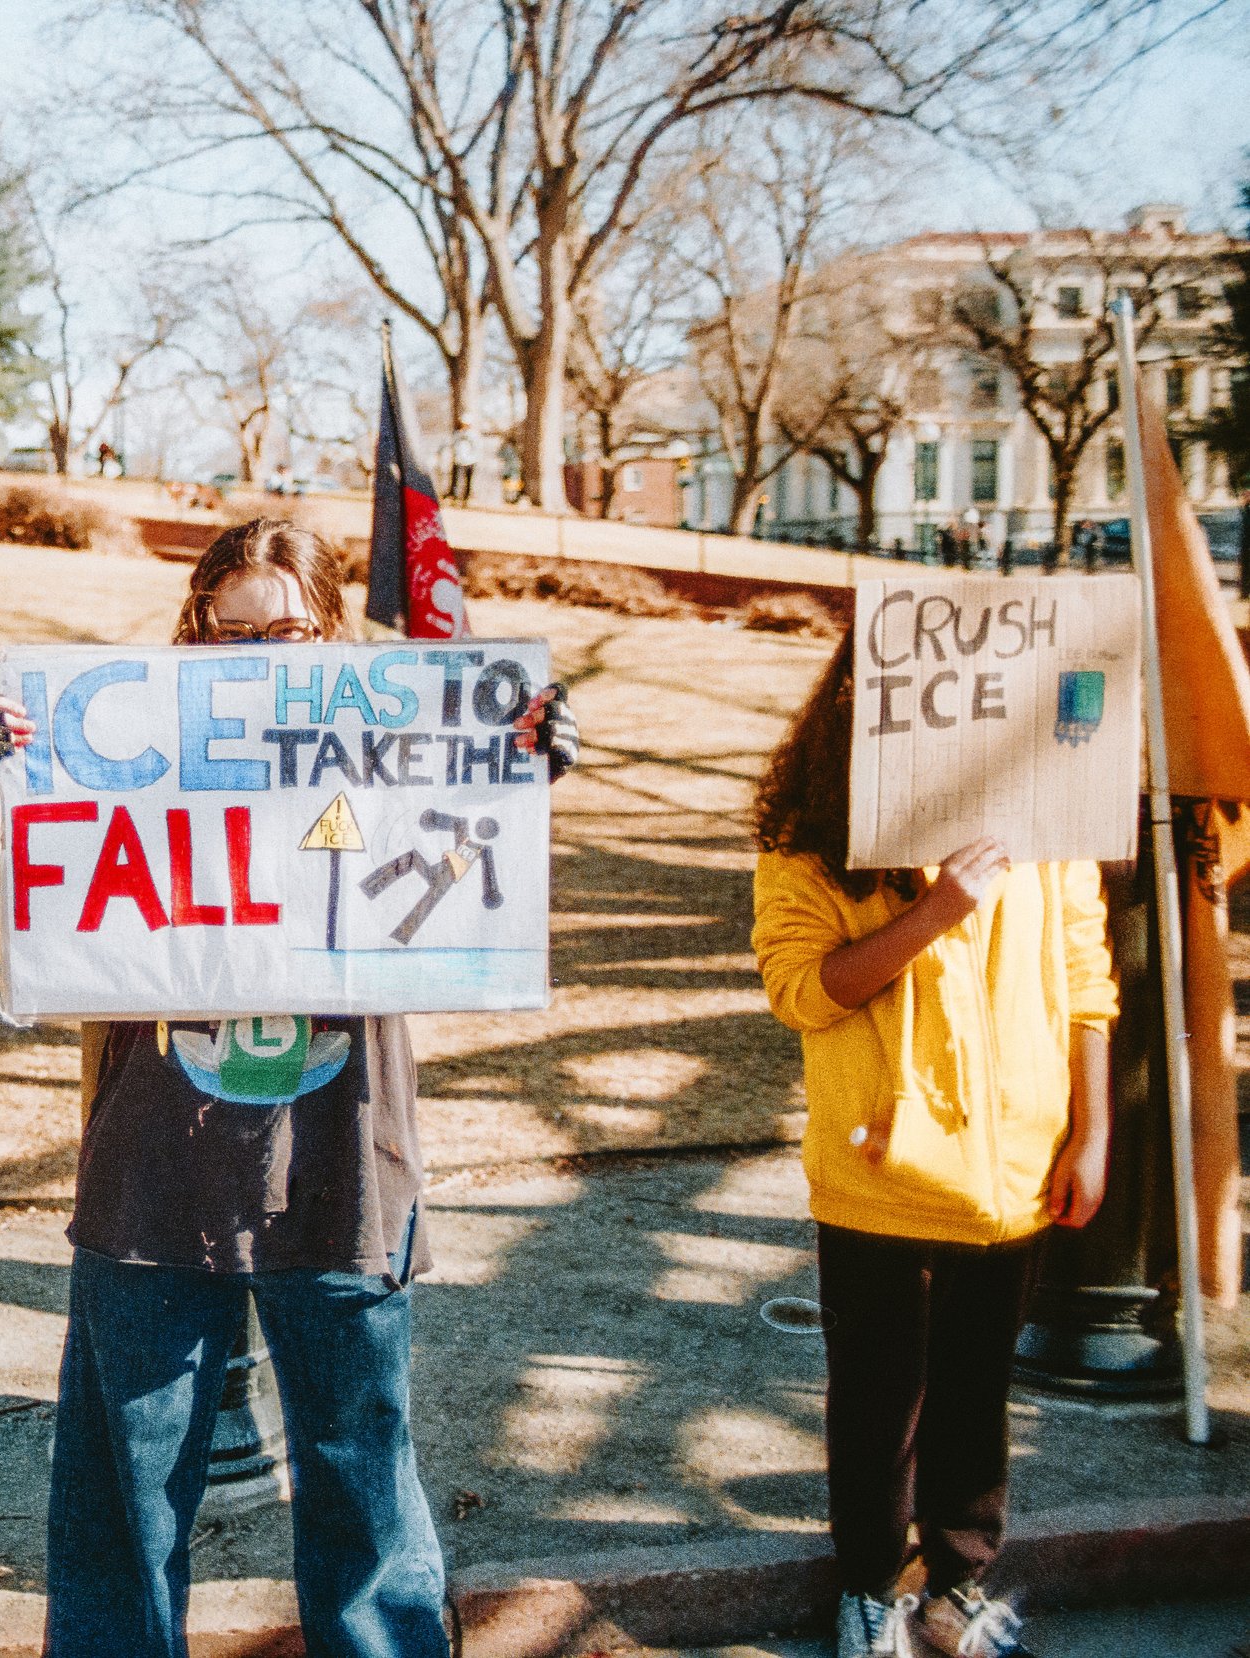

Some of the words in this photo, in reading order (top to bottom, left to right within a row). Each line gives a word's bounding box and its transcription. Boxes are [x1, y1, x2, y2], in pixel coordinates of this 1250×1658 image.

[867, 589, 1057, 669] CRUSH
[22, 657, 271, 795] ICE
[275, 650, 419, 729] HAS
[423, 649, 530, 727] TO
[865, 670, 1006, 737] ICE
[262, 728, 434, 788] TAKE
[436, 731, 535, 785] THE
[11, 801, 283, 932] FALL
